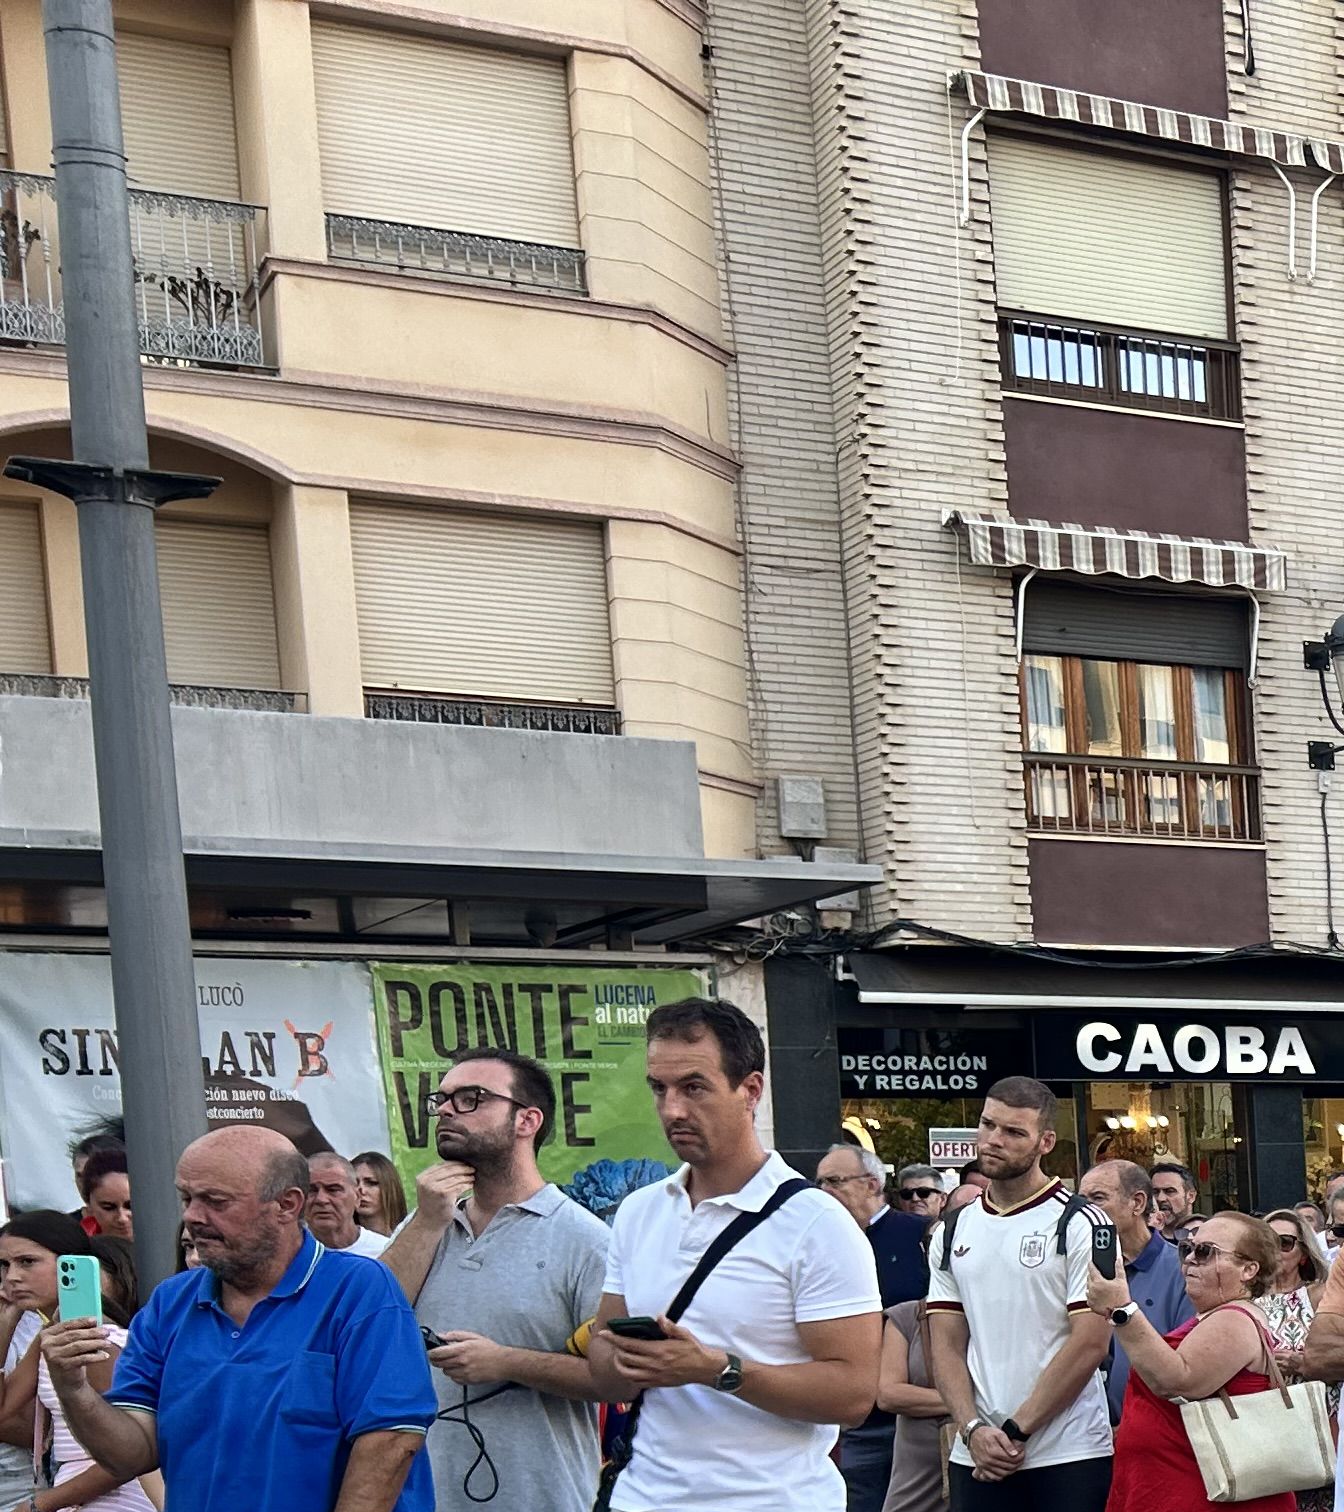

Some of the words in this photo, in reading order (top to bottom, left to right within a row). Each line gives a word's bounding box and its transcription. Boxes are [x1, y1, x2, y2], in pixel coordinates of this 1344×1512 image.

[594, 984, 656, 1005] LUCENA
[384, 980, 593, 1060] PONTE
[595, 1004, 611, 1024] al
[38, 1028, 120, 1076] SIN
[294, 1031, 328, 1077] B
[1076, 1022, 1316, 1074] CAOBA
[842, 1052, 987, 1071] DECORACIÓN
[853, 1074, 868, 1090] Y
[875, 1074, 978, 1090] REGALOS
[232, 1088, 266, 1101] nuevo
[269, 1087, 300, 1101] disco
[932, 1142, 977, 1157] OFERT
